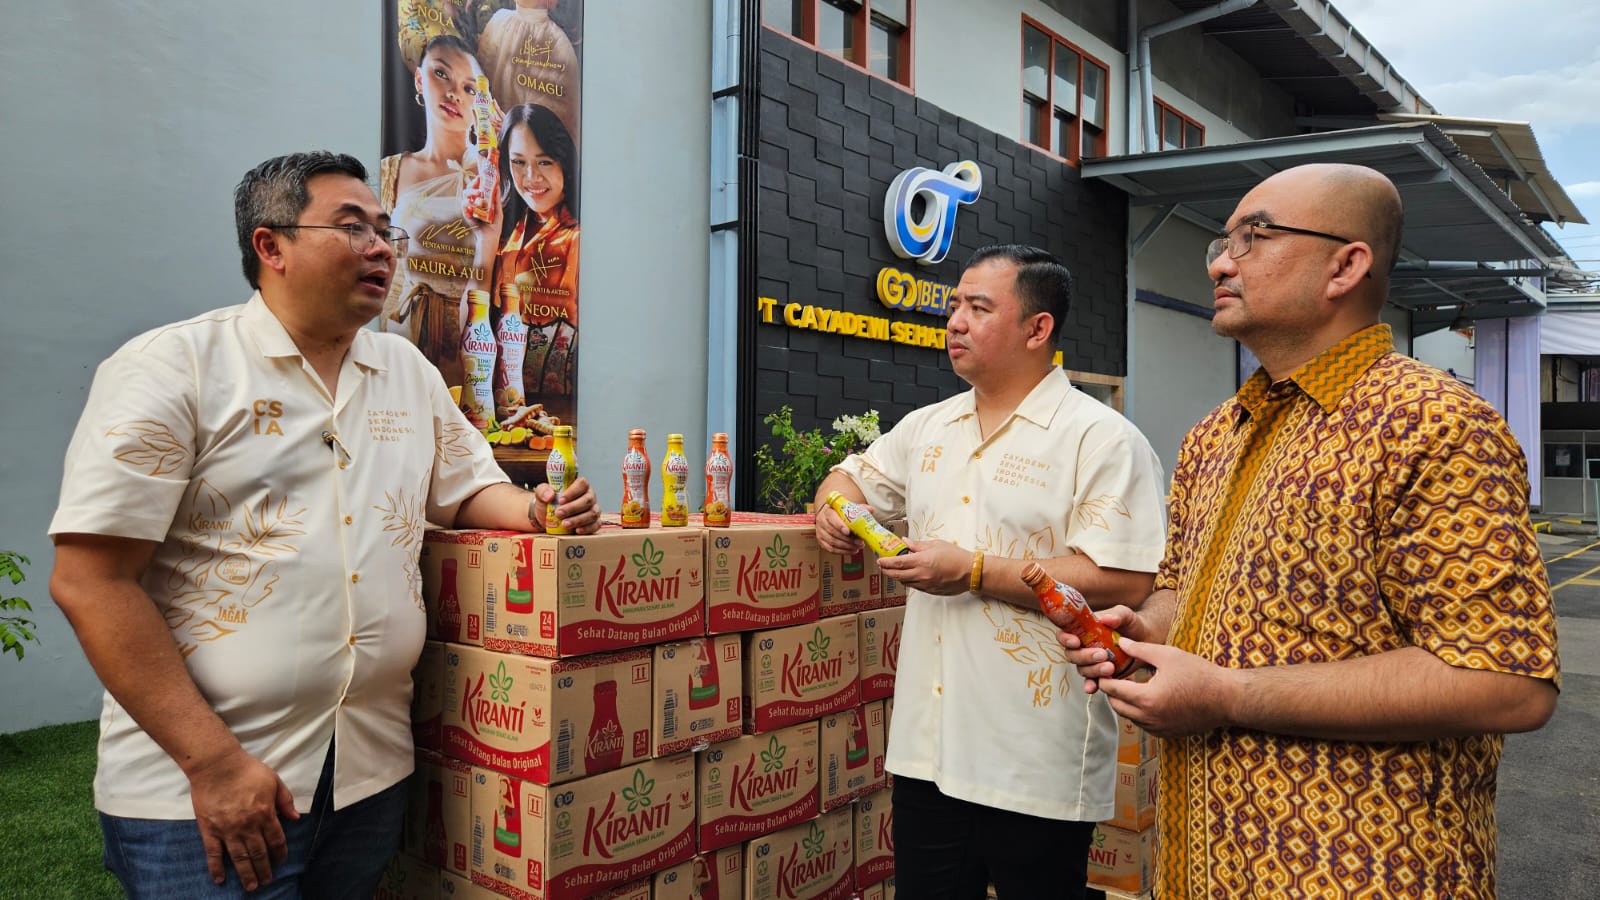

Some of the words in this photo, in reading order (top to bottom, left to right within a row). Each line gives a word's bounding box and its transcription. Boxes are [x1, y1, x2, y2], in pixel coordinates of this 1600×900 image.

[417, 5, 454, 27] NOLA
[517, 74, 564, 97] OMAGU
[408, 257, 457, 277] NAURA
[459, 266, 485, 281] AYU
[877, 267, 918, 310] GO
[917, 279, 957, 312] BEY
[524, 303, 569, 319] NEONA
[758, 296, 777, 323] T
[784, 302, 889, 341] CAYADEWI
[890, 321, 947, 349] SEHAT
[253, 399, 284, 418] CS
[254, 418, 284, 436] IA
[923, 445, 944, 458] CS
[469, 616, 478, 627] 24
[541, 613, 552, 625] 24
[722, 608, 744, 620] Sehat
[745, 611, 770, 625] Datang
[771, 612, 791, 623] Bulan
[792, 601, 817, 620] Original
[577, 626, 606, 640] Sehat
[607, 627, 640, 643] Datang
[642, 626, 667, 640] Bulan
[668, 610, 700, 633] Original
[729, 699, 738, 711] 24
[768, 707, 789, 718] Sehat
[790, 707, 814, 719] Datang
[814, 701, 833, 713] Bulan
[833, 685, 857, 706] Original
[636, 731, 646, 745] 24
[450, 731, 468, 747] Sehat
[468, 740, 491, 765] Datang
[492, 754, 512, 769] Bulan
[512, 754, 542, 772] Original
[714, 823, 737, 836] Sehat
[739, 821, 765, 833] Datang
[767, 814, 788, 829] Bulan
[788, 795, 816, 819] Original
[529, 861, 540, 874] 24
[564, 872, 594, 889] Sehat
[596, 868, 629, 883] Datang
[631, 857, 657, 876] Bulan
[658, 832, 692, 862] Original
